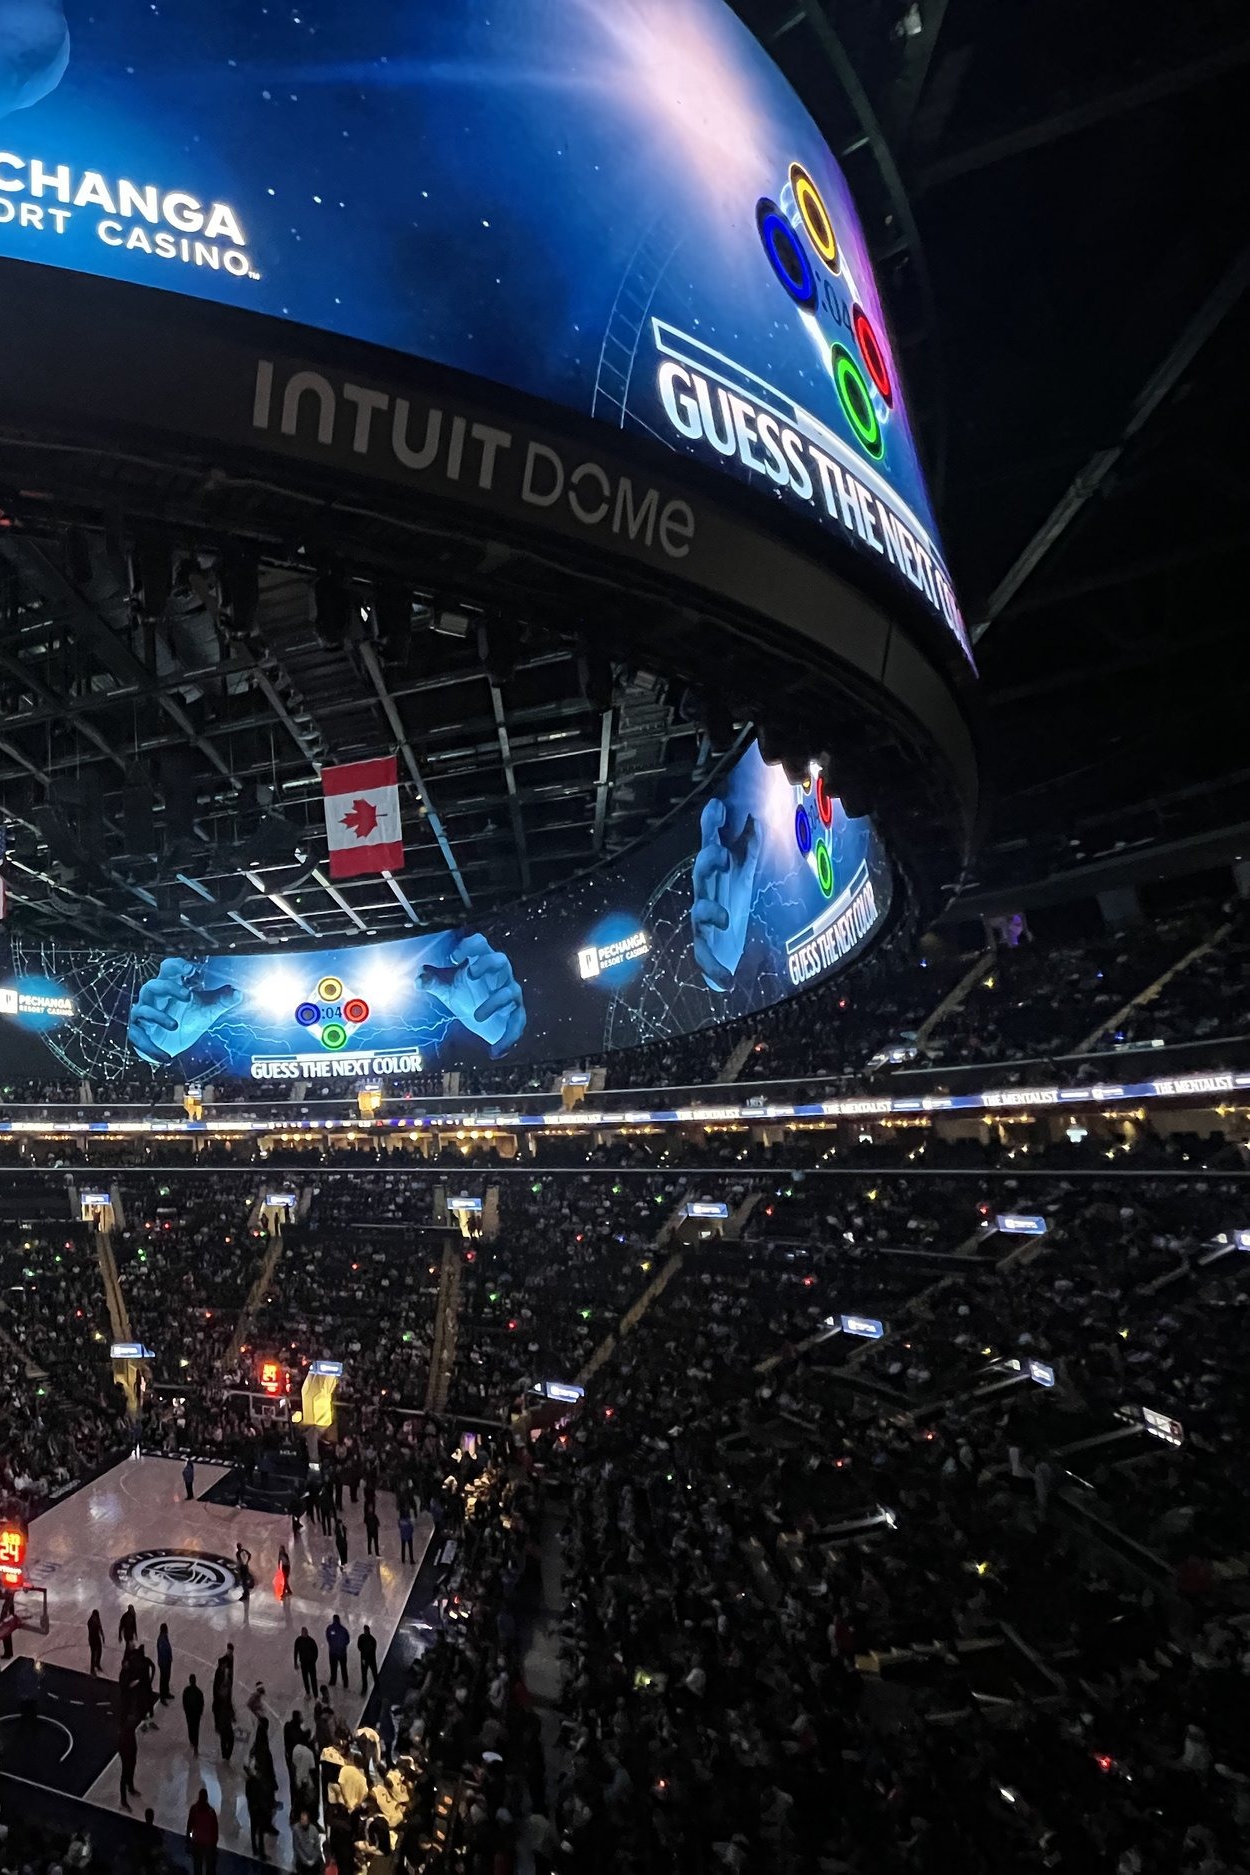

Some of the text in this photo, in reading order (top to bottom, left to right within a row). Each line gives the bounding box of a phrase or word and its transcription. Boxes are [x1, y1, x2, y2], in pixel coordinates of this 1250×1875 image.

[658, 361, 940, 611] GUESS THE NEXT
[788, 880, 879, 986] GUESS THE NEXT COLOR
[251, 1055, 422, 1079] GUESS THE NEXT COLOR
[1152, 1081, 1176, 1095] THE
[1174, 1075, 1233, 1094] MENTALIST
[981, 1094, 1000, 1107] THE
[1001, 1090, 1058, 1106] MENTALIST
[0, 1543, 20, 1563] 24
